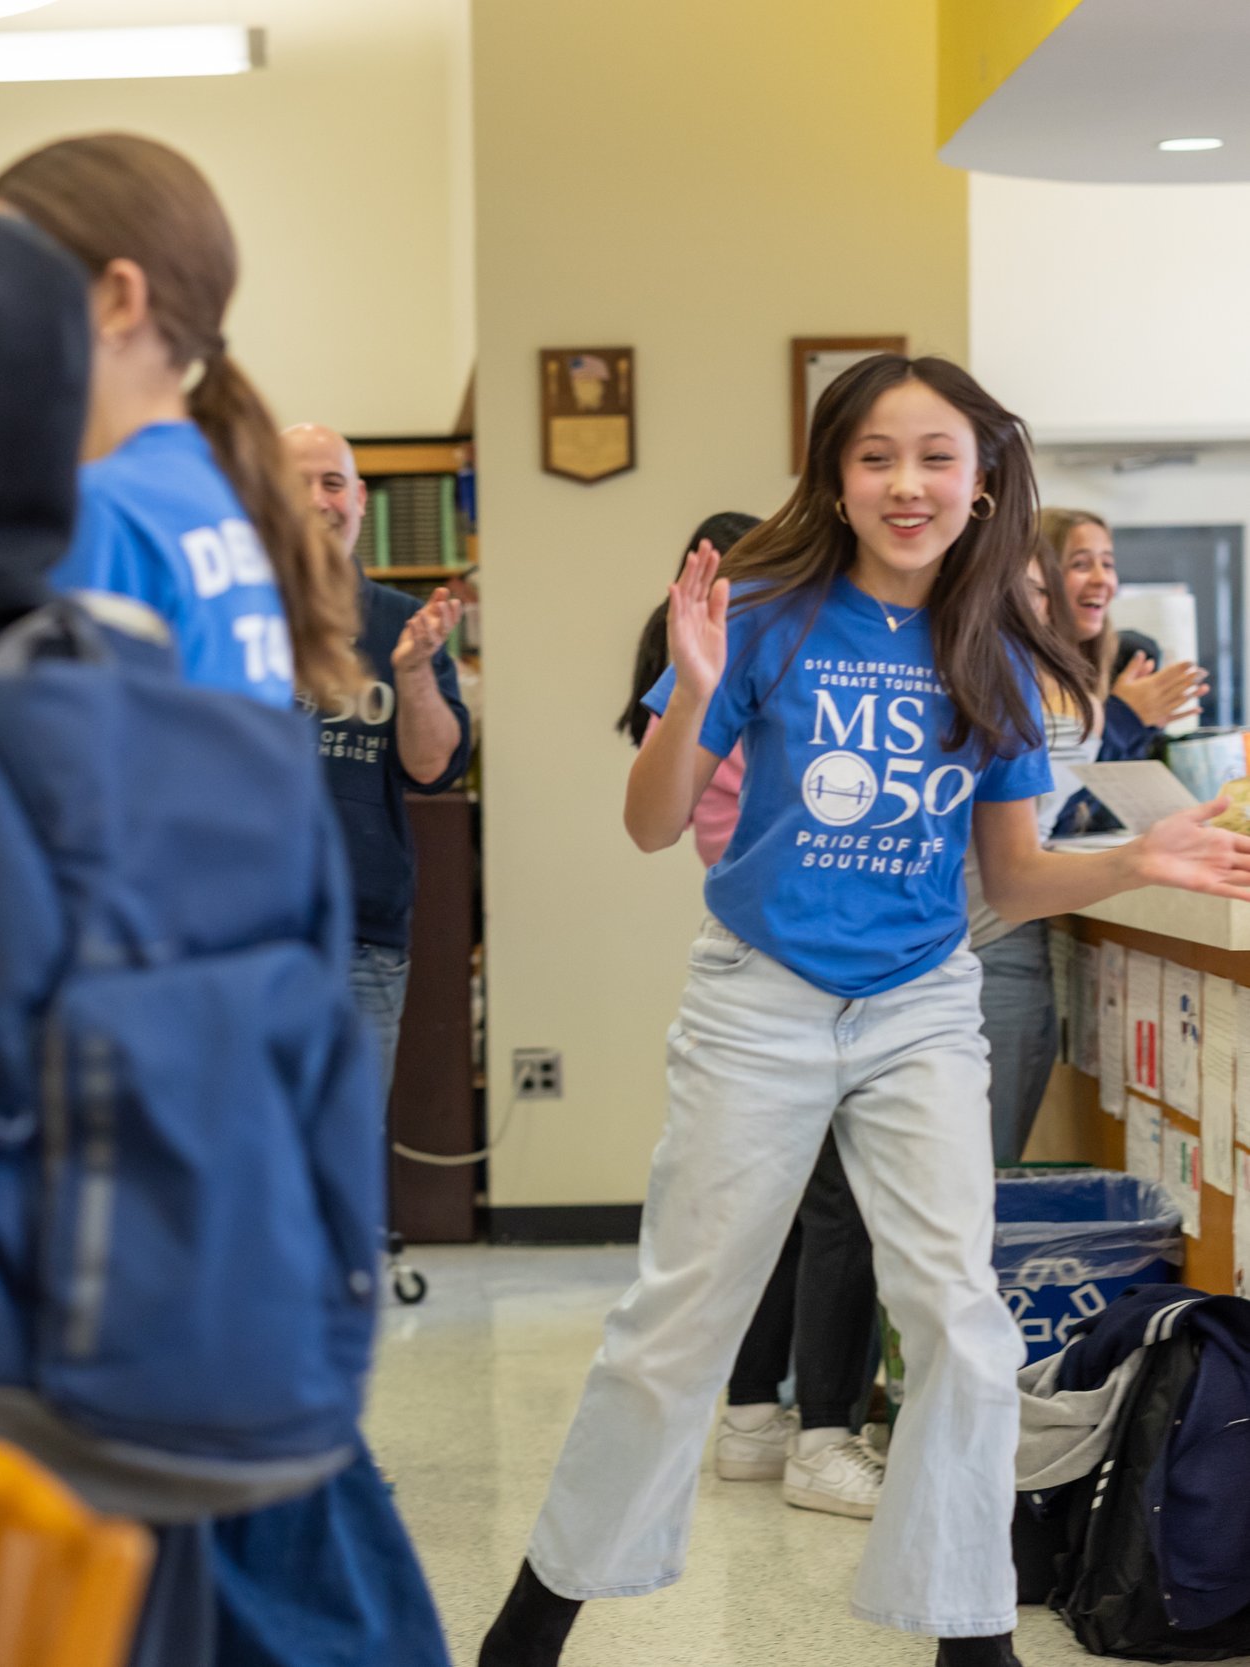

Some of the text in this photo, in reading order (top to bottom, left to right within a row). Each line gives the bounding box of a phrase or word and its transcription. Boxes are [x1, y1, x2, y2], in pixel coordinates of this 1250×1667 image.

[837, 660, 933, 678] ELEMENTARY
[819, 673, 878, 689] DEBATE
[807, 689, 925, 754] MS
[320, 730, 348, 744] OF
[870, 757, 975, 829] 50
[795, 830, 871, 850] PRIDE
[877, 836, 911, 853] OF
